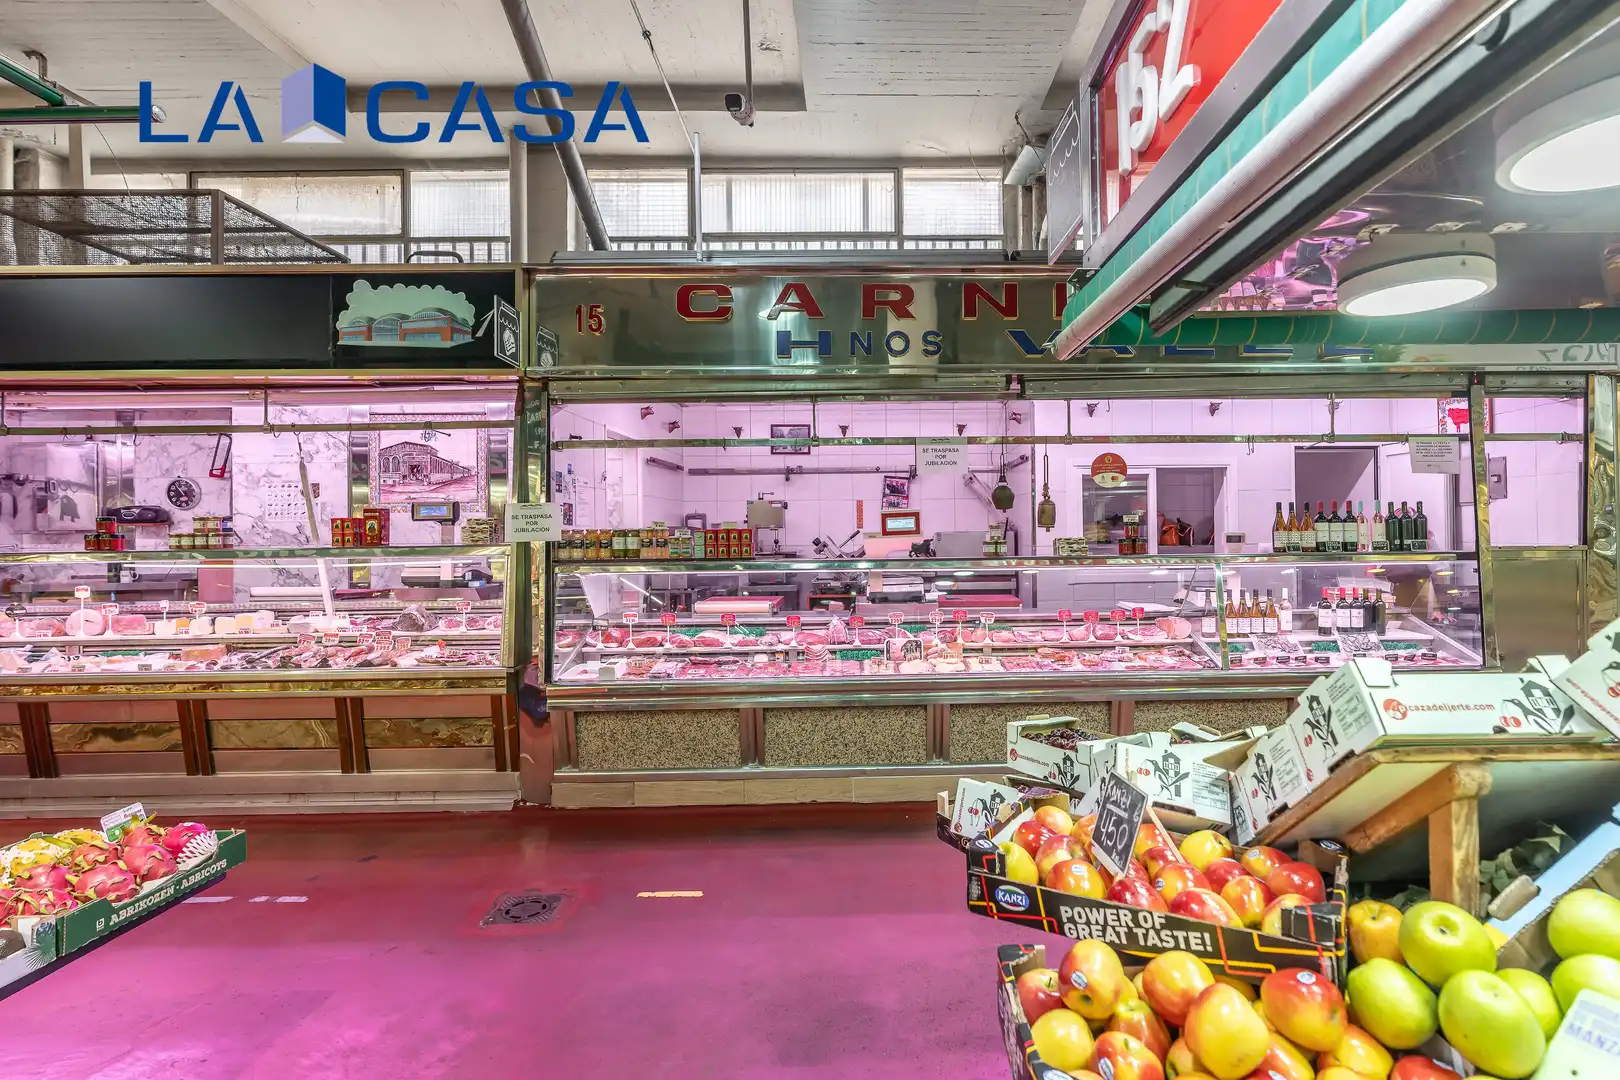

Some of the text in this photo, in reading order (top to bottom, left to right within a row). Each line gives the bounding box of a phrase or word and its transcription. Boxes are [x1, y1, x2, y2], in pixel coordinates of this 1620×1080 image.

[576, 304, 605, 335] 15
[109, 858, 228, 926] ABRIKOZEN ABRICOTS
[1060, 905, 1166, 930] POWER OF
[1063, 922, 1213, 952] GREAT TASTE!
